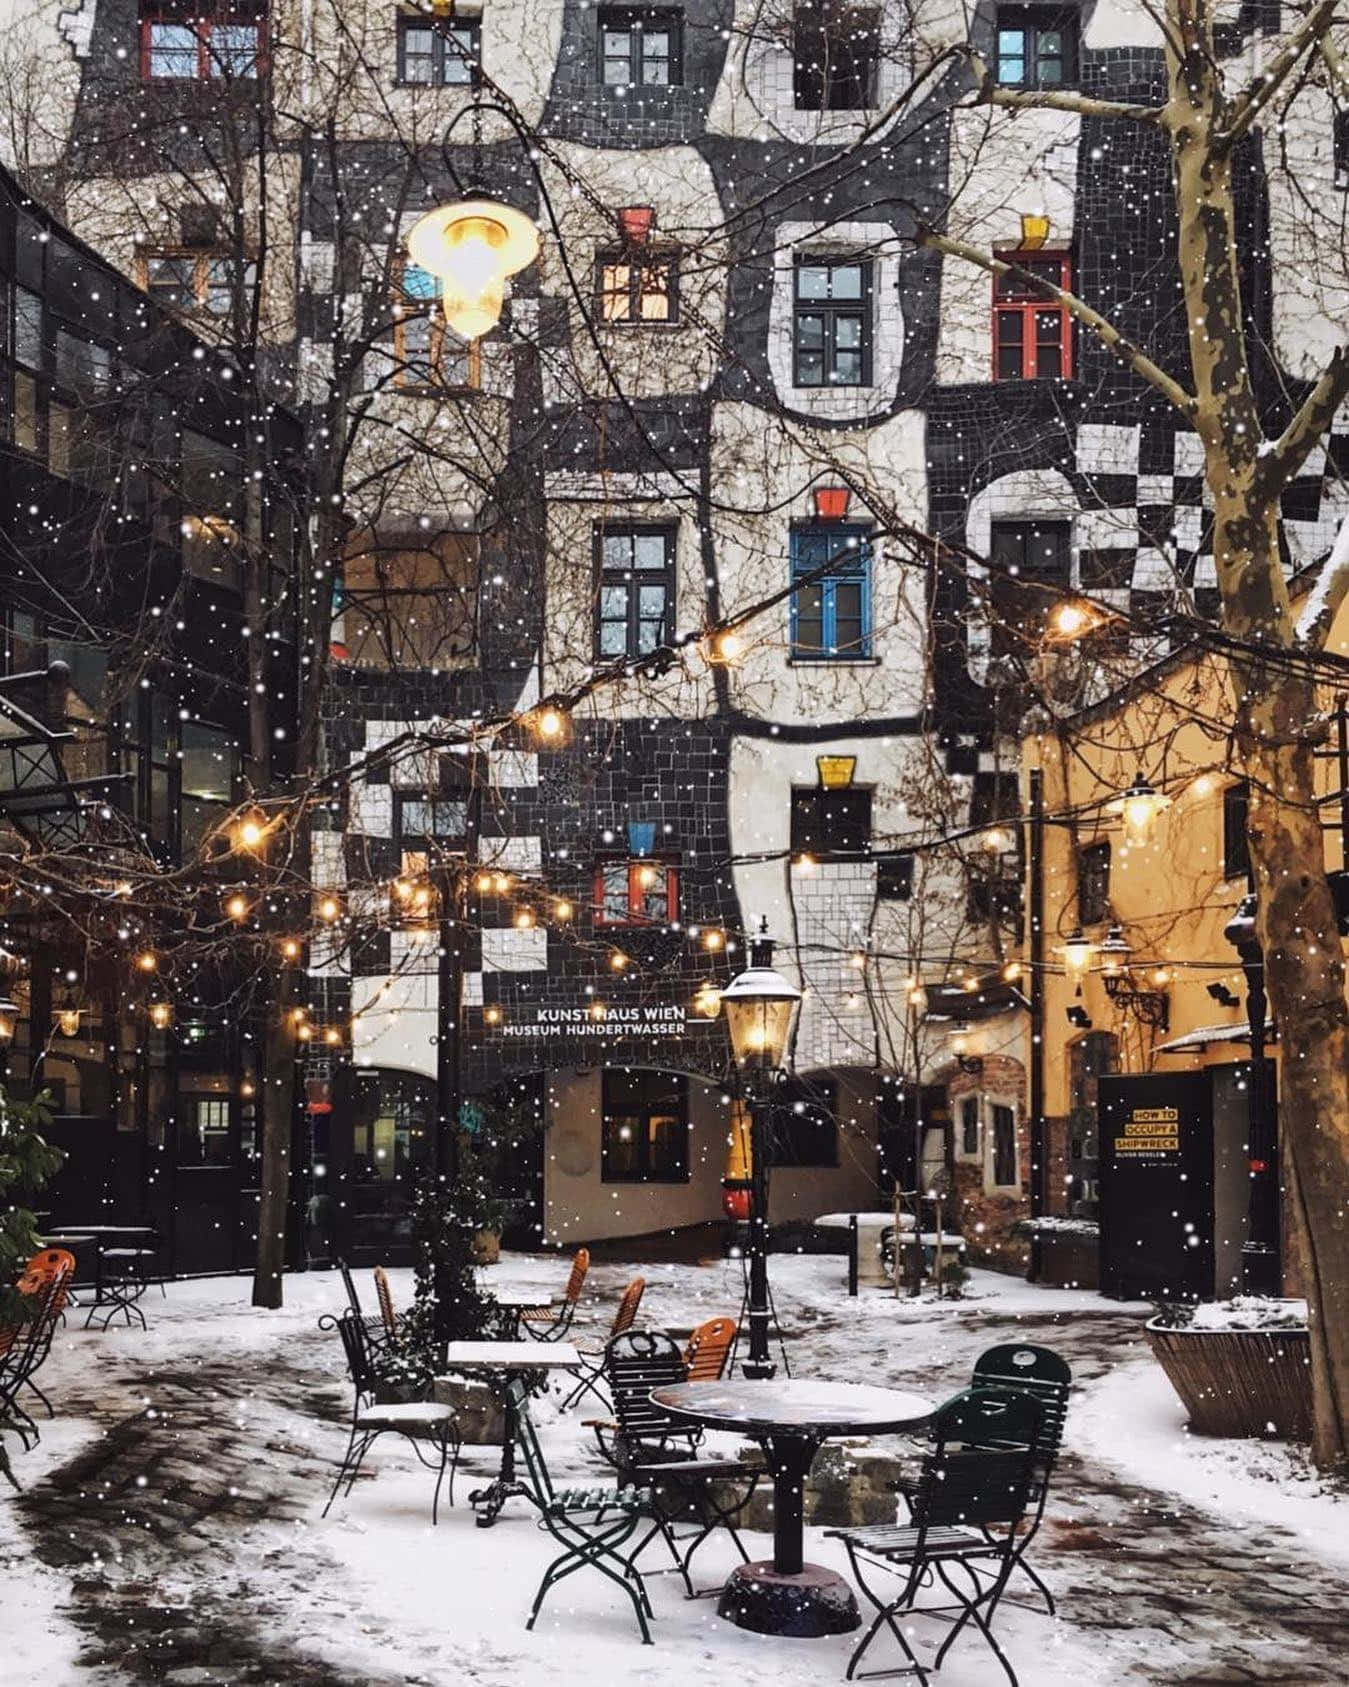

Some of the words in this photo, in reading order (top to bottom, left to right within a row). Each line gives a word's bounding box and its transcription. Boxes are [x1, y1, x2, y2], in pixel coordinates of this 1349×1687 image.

[537, 1009, 592, 1021] KUNST
[597, 1008, 640, 1021] HAUS
[644, 1006, 686, 1020] WIEN
[503, 1024, 561, 1036] MUSEUM
[566, 1023, 686, 1035] HUNDERTWASSER
[1135, 1111, 1159, 1120] HOW
[1162, 1110, 1176, 1119] TO
[1127, 1125, 1167, 1134] OCCUPY
[1169, 1125, 1177, 1133] A
[1117, 1139, 1177, 1148] SHIPWRECK
